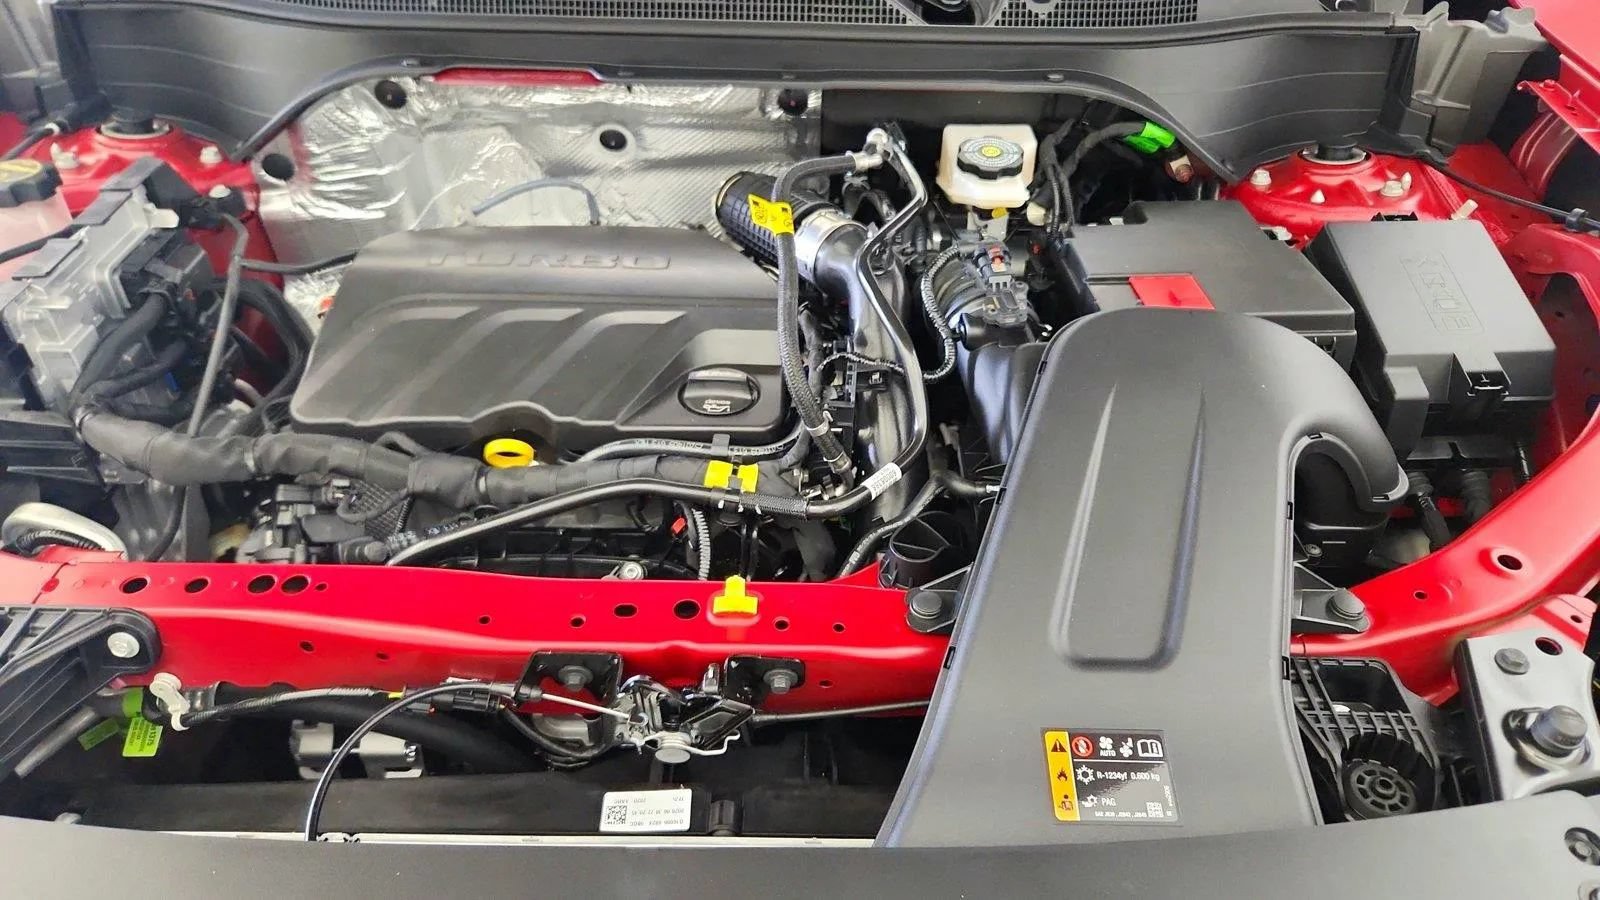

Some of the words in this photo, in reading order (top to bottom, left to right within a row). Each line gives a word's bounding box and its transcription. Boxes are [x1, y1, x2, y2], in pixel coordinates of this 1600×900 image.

[428, 252, 671, 270] TURBO
[1099, 749, 1116, 757] AUTO
[1096, 771, 1128, 781] R-1234yf
[1151, 772, 1160, 782] kg
[1101, 797, 1117, 807] PAG
